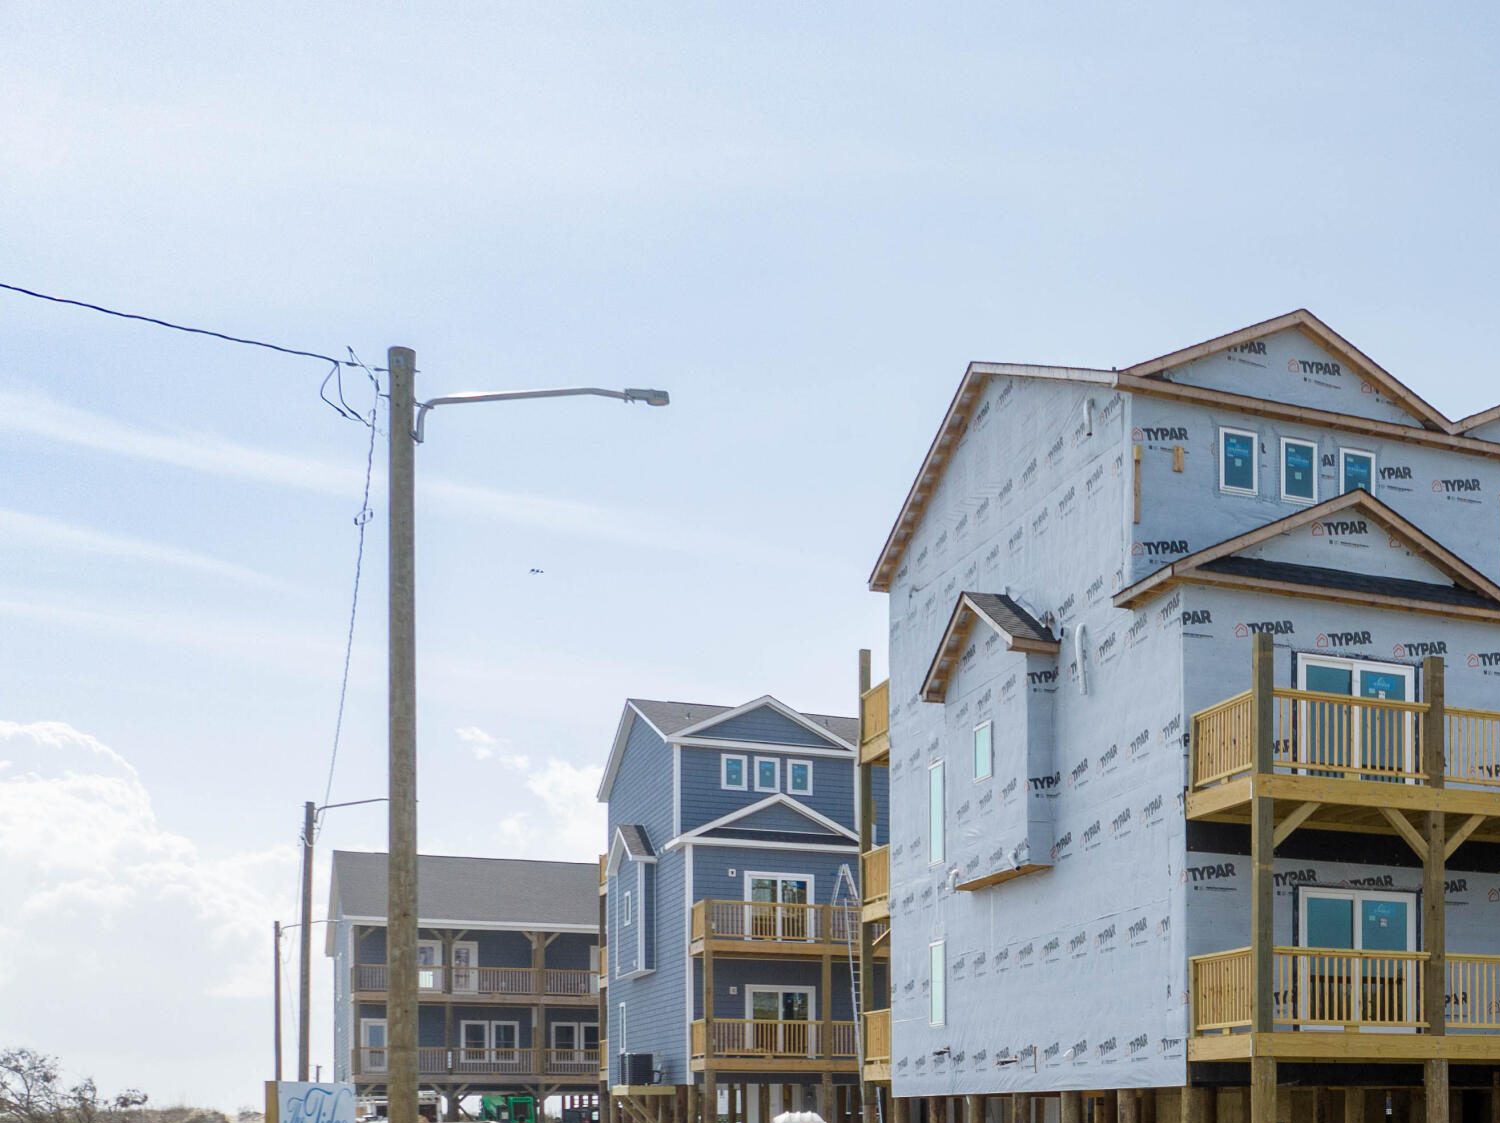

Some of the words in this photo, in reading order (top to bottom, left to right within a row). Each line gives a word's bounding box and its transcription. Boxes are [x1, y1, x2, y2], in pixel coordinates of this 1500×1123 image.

[1299, 359, 1342, 377] TYPAR
[998, 380, 1013, 404] TYPAR
[976, 401, 990, 424] TYPAR
[1104, 392, 1122, 419] TYPAR
[1143, 427, 1189, 442] TYPAR
[1047, 436, 1064, 464] TYPAR
[1022, 458, 1037, 483] TYPAR
[1086, 464, 1104, 490] TYPAR
[1379, 466, 1413, 481] YPAR
[998, 478, 1013, 503] TYPAR
[1441, 478, 1481, 492] TYPAR
[1058, 486, 1075, 513] TYPAR
[1031, 507, 1048, 533] TYPAR
[1322, 520, 1368, 536] TYPAR
[1143, 540, 1190, 555] TYPAR
[1086, 575, 1104, 601] TYPAR
[1057, 592, 1075, 619] TYPAR
[1128, 611, 1148, 640] TYPAR
[1182, 609, 1213, 625] PAR
[1248, 620, 1295, 635] TYPAR
[1099, 631, 1116, 660] TYPAR
[1327, 630, 1373, 647] TYPAR
[1404, 640, 1448, 657] TYPAR
[962, 644, 976, 666] TYPAR
[1001, 674, 1017, 696] TYPAR
[1028, 665, 1059, 685] TYPAR
[977, 688, 992, 711] TYPAR
[1130, 729, 1149, 754] TYPAR
[1100, 744, 1118, 769] TYPAR
[1071, 758, 1089, 781] TYPAR
[1001, 778, 1017, 799] TYPAR
[1029, 771, 1061, 791] TYPAR
[978, 790, 993, 810] TYPAR
[1143, 795, 1163, 820] TYPAR
[1112, 808, 1131, 832] TYPAR
[1083, 820, 1101, 844] TYPAR
[1055, 832, 1072, 856] TYPAR
[989, 847, 1003, 867] TYPAR
[1188, 862, 1237, 882] TYPAR
[1273, 868, 1317, 887] TYPAR
[1444, 878, 1468, 895] PAR
[1098, 923, 1116, 947] TYPAR
[1128, 917, 1147, 940] TYPAR
[1018, 942, 1034, 963] TYPAR
[1043, 936, 1060, 958] TYPAR
[1069, 931, 1086, 953] TYPAR
[995, 947, 1009, 967] TYPAR
[1444, 991, 1468, 1008] PAR
[1019, 1043, 1034, 1063] TYPAR
[1044, 1041, 1060, 1061] TYPAR
[1098, 1036, 1117, 1057] TYPAR
[1129, 1033, 1148, 1055] TYPAR
